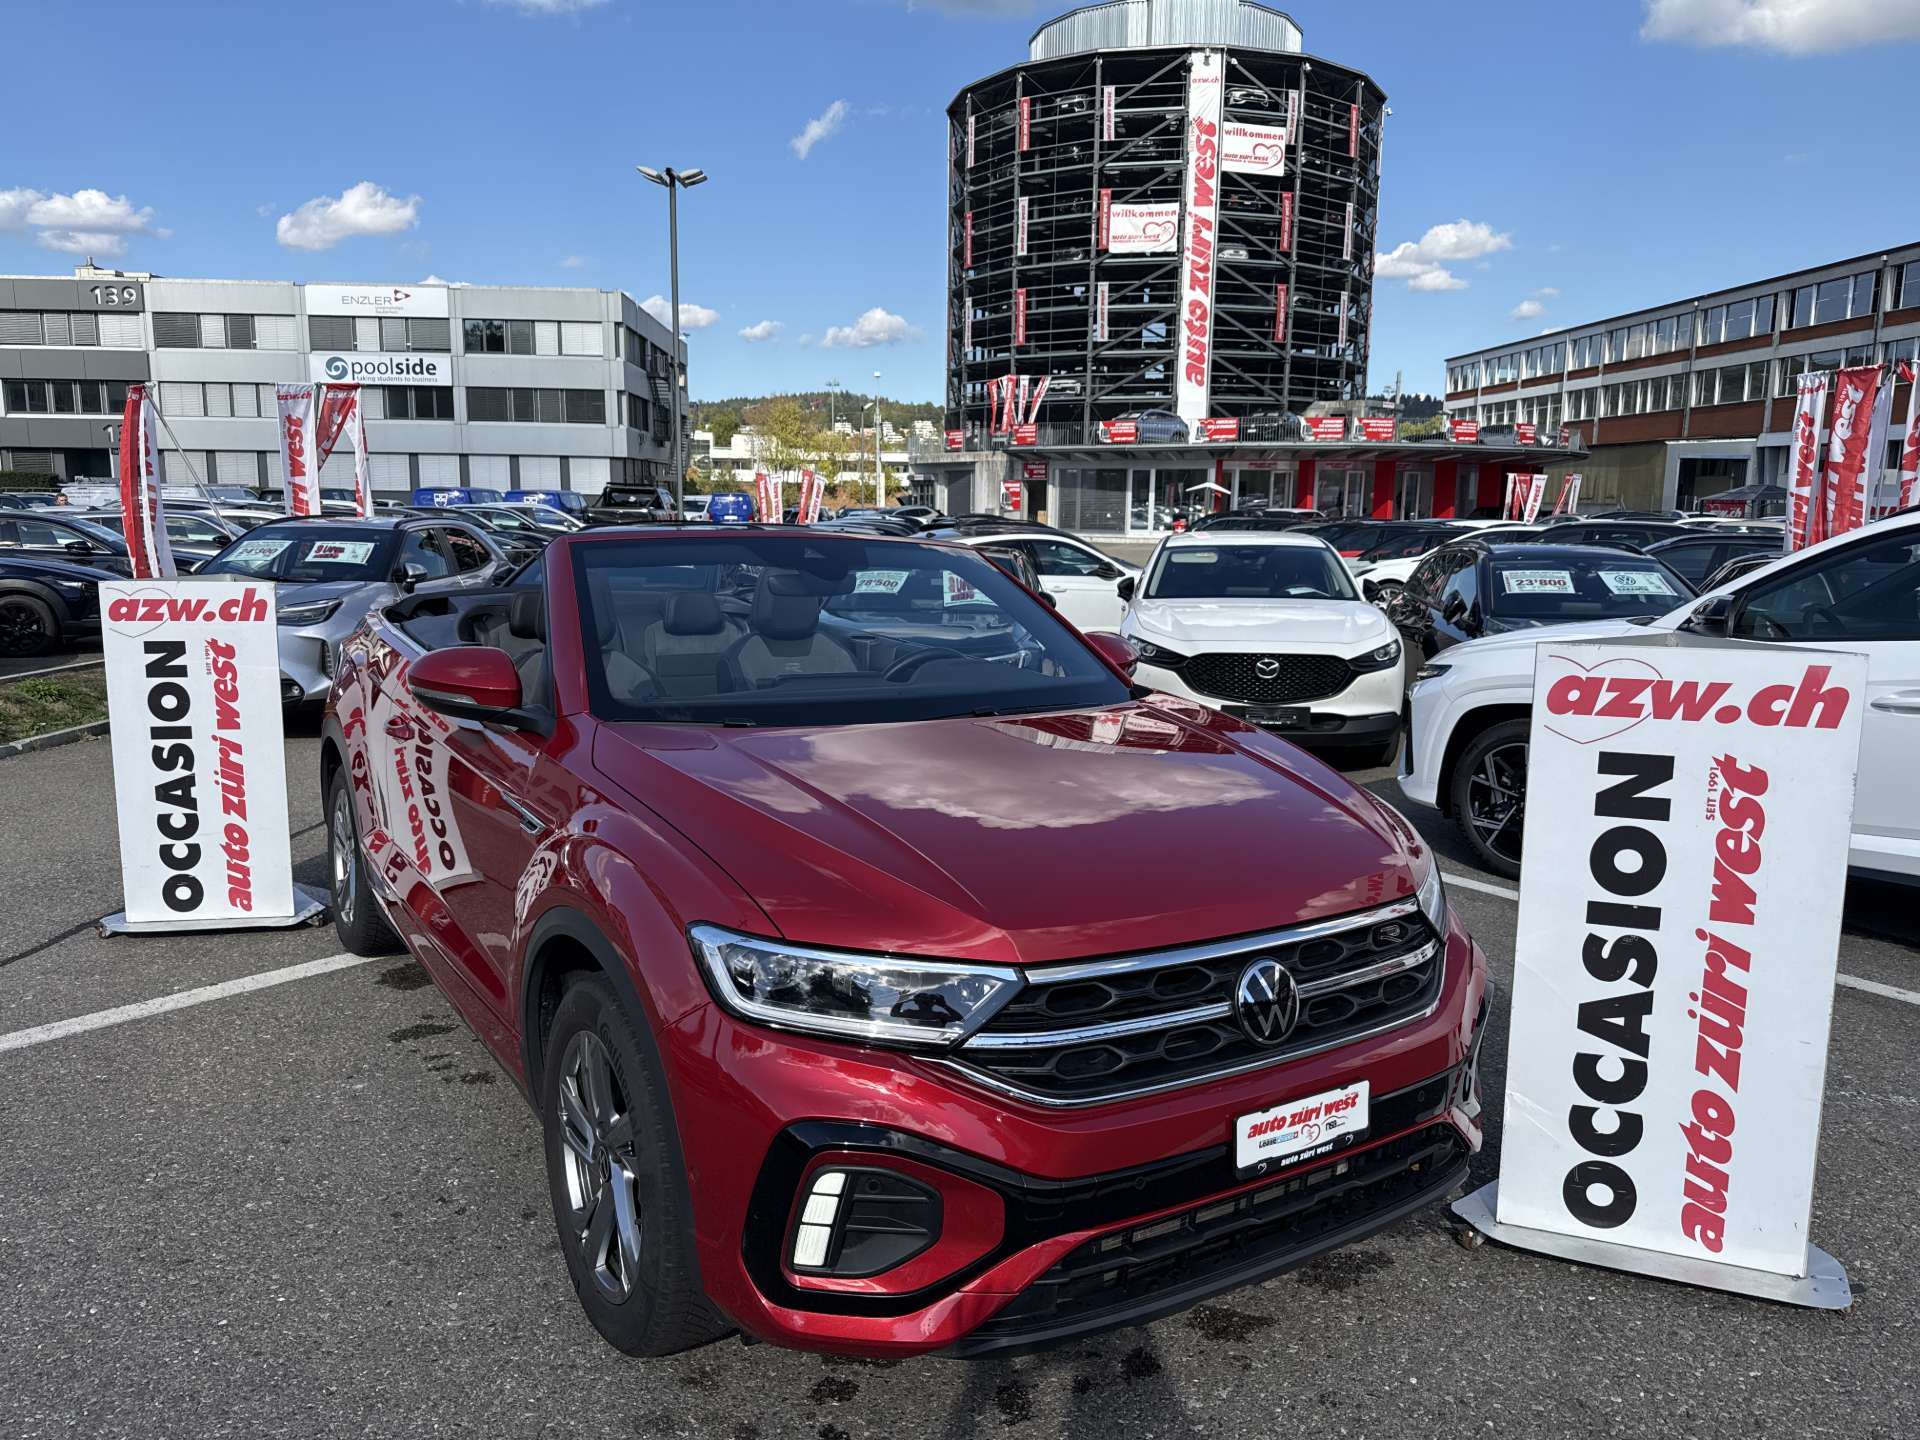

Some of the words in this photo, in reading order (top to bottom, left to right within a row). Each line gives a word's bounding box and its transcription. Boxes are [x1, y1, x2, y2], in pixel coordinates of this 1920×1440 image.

[1193, 116, 1216, 207] west
[1224, 128, 1284, 140] willkommen
[1112, 209, 1176, 218] willkommen
[1184, 211, 1212, 298] züri
[90, 286, 136, 306] 139
[342, 296, 392, 305] ENZLER
[352, 358, 436, 381] poolside
[1184, 299, 1208, 387] auto
[284, 413, 306, 478] west
[1795, 410, 1816, 488] west
[108, 588, 268, 622] azw.ch
[204, 638, 241, 730] west
[1547, 665, 1851, 730] azw.ch
[144, 640, 204, 912] OCCASION
[212, 734, 247, 823] züri
[1706, 792, 1716, 821] SEIT
[1708, 766, 1719, 791] 1991
[220, 822, 252, 912] auto
[1708, 753, 1771, 926] west
[1562, 751, 1676, 1230] OCCASION
[1688, 927, 1752, 1094] züri
[1248, 1115, 1287, 1139] auto
[1288, 1102, 1323, 1128] züri
[1324, 1093, 1358, 1116] west
[1280, 1154, 1299, 1166] auto
[1316, 1143, 1334, 1154] west
[1678, 1089, 1736, 1254] auto
